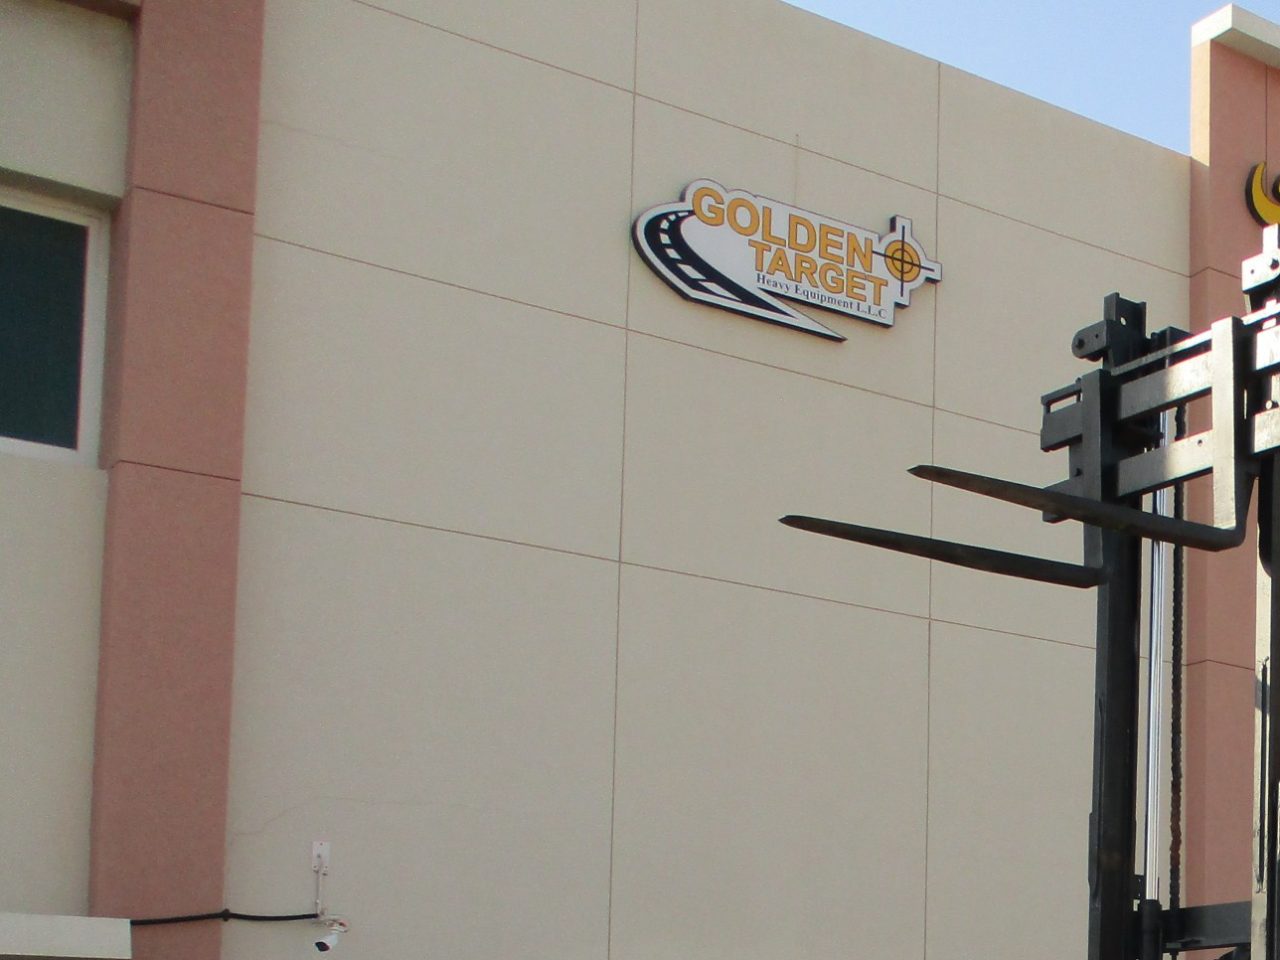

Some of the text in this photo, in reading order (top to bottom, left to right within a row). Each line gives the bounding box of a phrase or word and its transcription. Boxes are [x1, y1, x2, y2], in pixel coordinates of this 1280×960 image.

[692, 186, 874, 273] GOLDEN
[748, 239, 889, 306] TARGET
[756, 272, 790, 294] Heavy
[794, 284, 853, 310] Equipment
